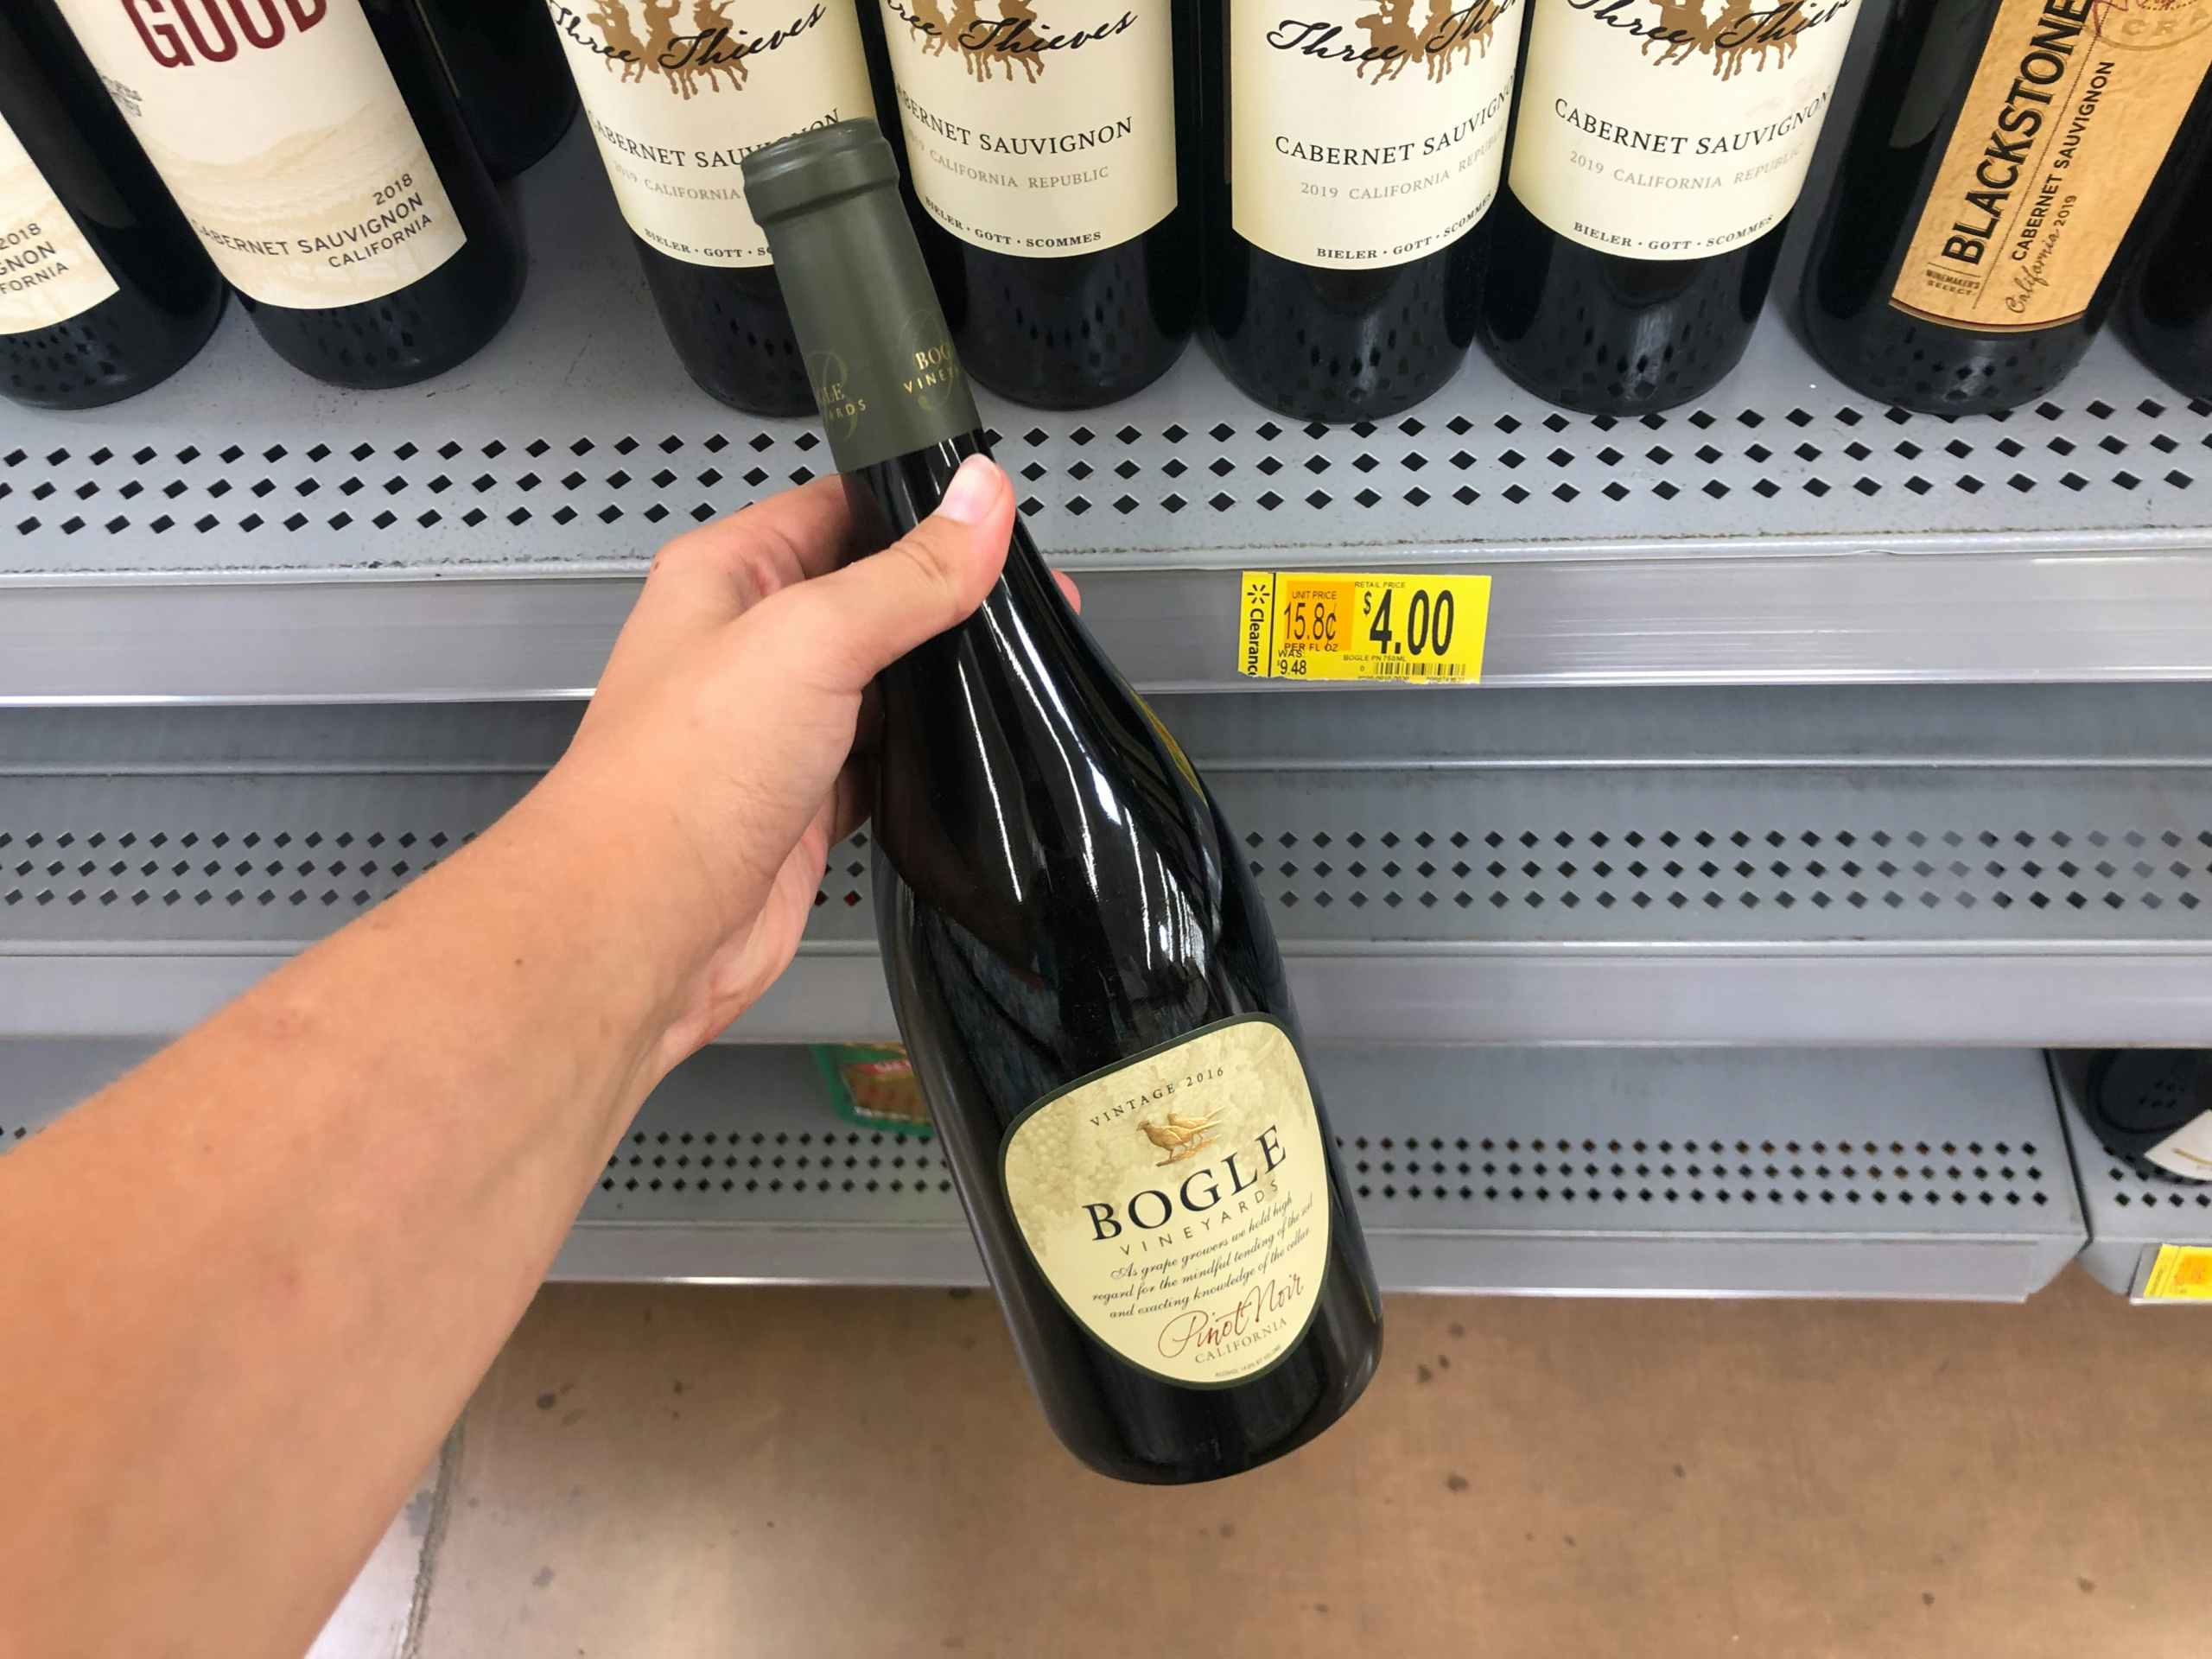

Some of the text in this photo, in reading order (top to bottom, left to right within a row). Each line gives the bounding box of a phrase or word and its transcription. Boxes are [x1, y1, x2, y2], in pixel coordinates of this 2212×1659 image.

[658, 3, 826, 69] Thieves
[887, 0, 1138, 53] ree Thieves
[1267, 19, 1407, 62] Three
[899, 84, 970, 146] BERNET
[979, 117, 1133, 155] SAUVIGNON
[1275, 75, 1514, 165] CABERNET SAUVIGN
[1554, 98, 1688, 155] CABERNET
[1942, 0, 2091, 264] BLACKSTONE
[929, 149, 1109, 188] CALIFORNIA REPUBLIC
[1300, 182, 1339, 200] 2019
[1349, 170, 1451, 200] CALIFORNIA
[1570, 150, 1605, 175] 2019
[1613, 168, 1723, 189] CALIFORNIA
[2012, 61, 2115, 261] CABERNET SAUVIGNON
[373, 173, 414, 206] 2018
[645, 179, 741, 200] CALIFORNIA
[297, 192, 423, 254] SAUVIGNON
[327, 213, 432, 268] CALIFORNIA
[975, 228, 1011, 245] GOTT
[1026, 231, 1102, 249] SCOMMES
[1317, 247, 1378, 260] BIELER
[1392, 236, 1433, 255] GOTT
[1573, 221, 1632, 247] BIELER
[1648, 240, 1693, 250] GOTT
[704, 248, 743, 257] GOTT
[2005, 195, 2077, 314] California 2019
[1292, 590, 1338, 600] UNIT PRICE
[1247, 607, 1265, 676] Clearanc
[1284, 643, 1306, 652] PER
[1363, 588, 1455, 657] $4.00
[1278, 649, 1303, 658] WAS
[1090, 1066, 1224, 1128] VINTAGE 2016
[1082, 1124, 1287, 1242] BOGLE
[1120, 1179, 1279, 1255] VINEYARDS
[1093, 1284, 1135, 1306] regard
[1136, 1279, 1155, 1300] for
[1160, 1276, 1179, 1290] the
[1182, 1251, 1231, 1283] mindful
[1109, 1262, 1138, 1280] As
[1141, 1258, 1178, 1280] grape
[1181, 1238, 1229, 1269] growers
[1109, 1303, 1135, 1318] and
[1137, 1296, 1190, 1314] exacting
[1193, 1267, 1255, 1300] knowledge
[1158, 1274, 1304, 1358] Pinot Noir
[1195, 1318, 1287, 1363] CALIFORNIA
